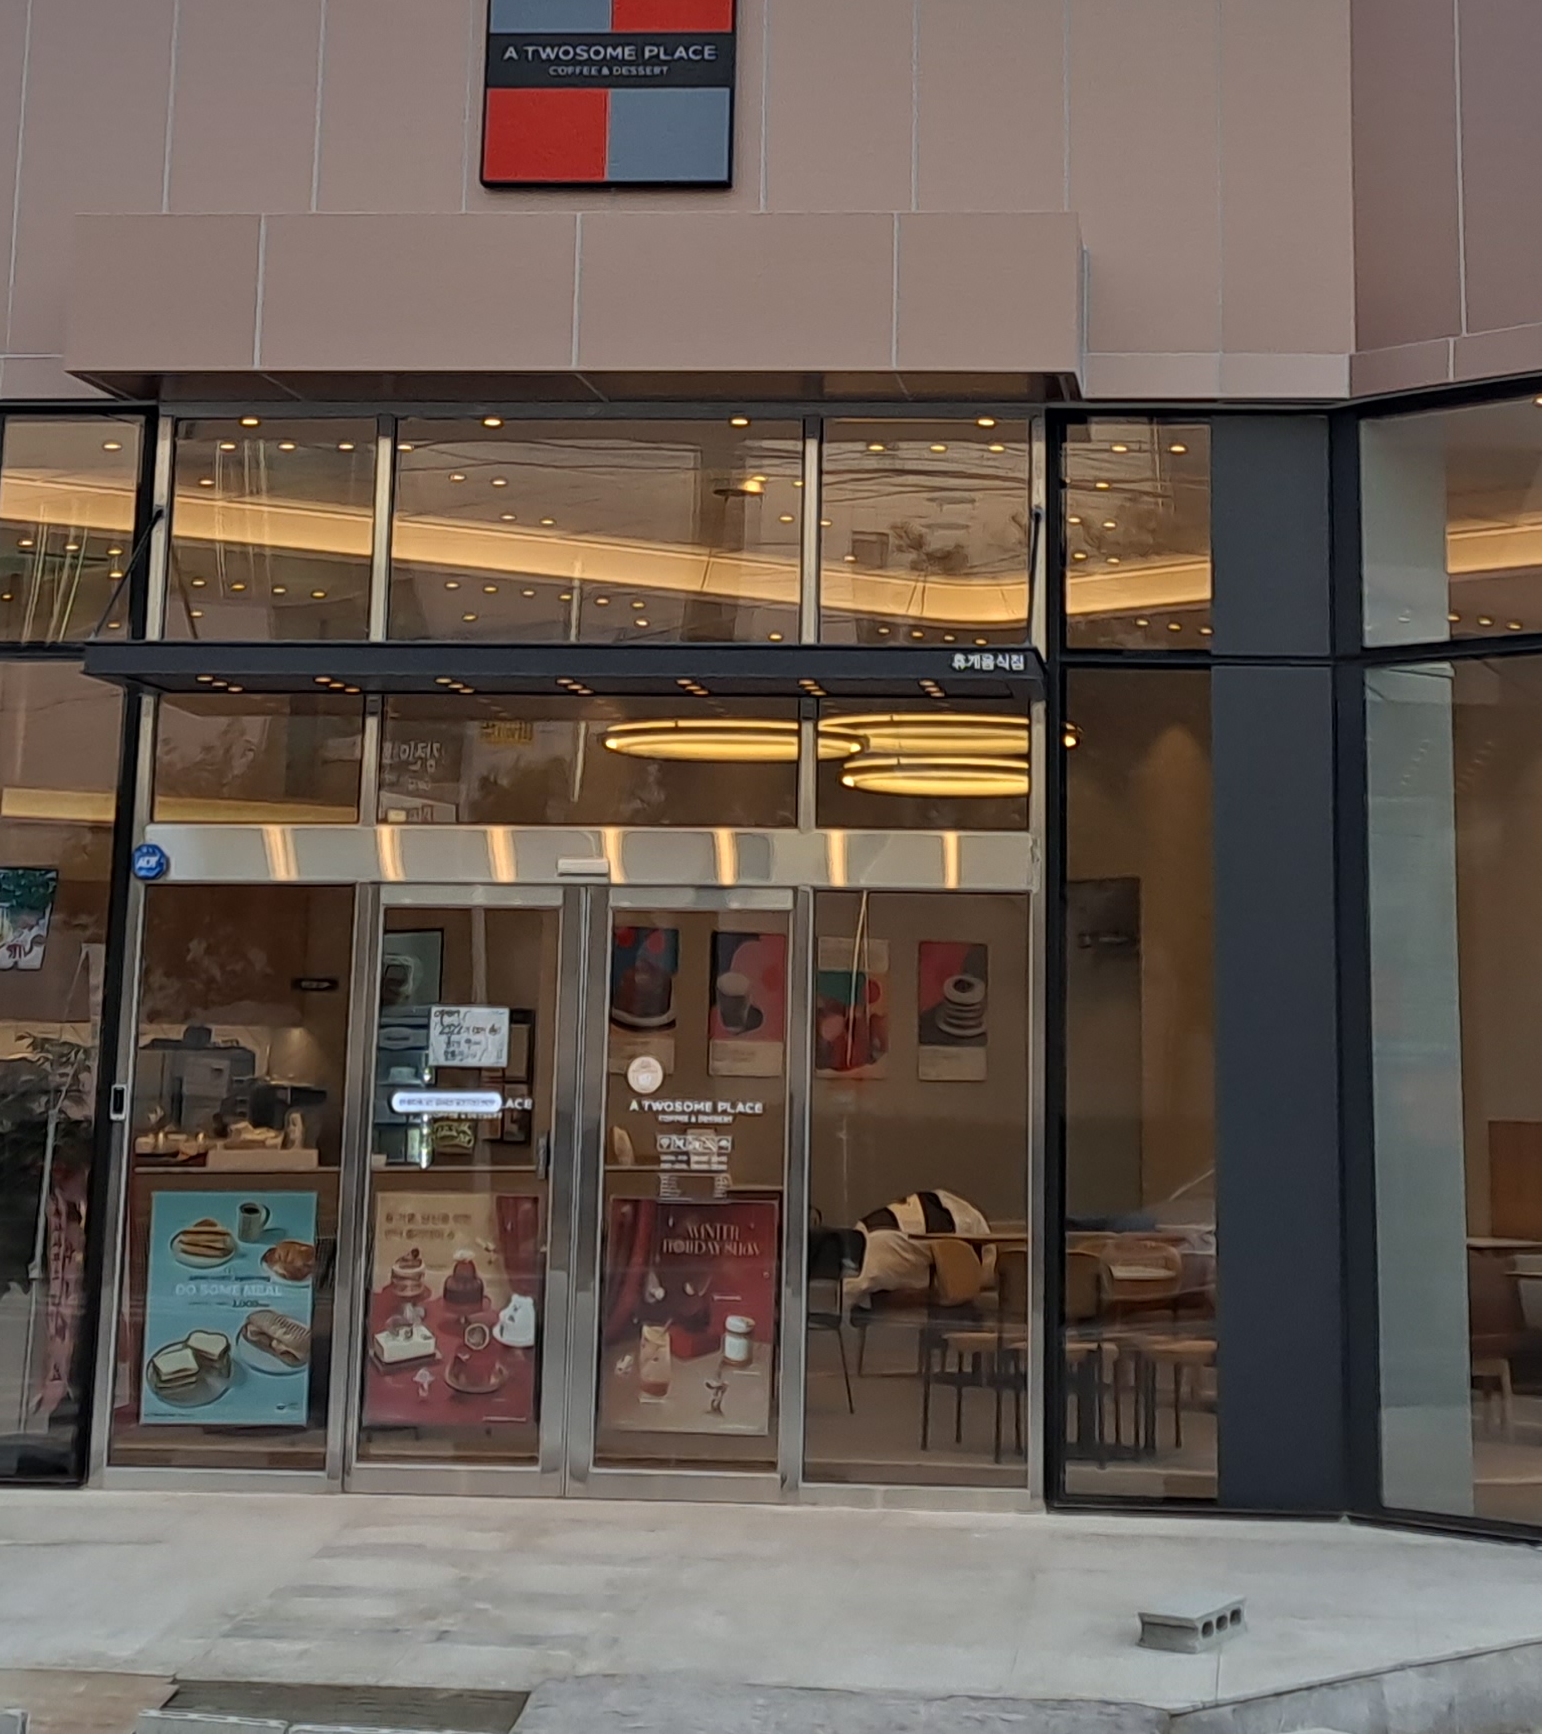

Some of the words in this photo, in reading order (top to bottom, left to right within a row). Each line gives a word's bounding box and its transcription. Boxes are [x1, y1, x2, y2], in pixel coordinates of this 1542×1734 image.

[503, 46, 518, 61] A
[523, 45, 637, 61] TWOSOME
[644, 45, 718, 61] PLACE
[549, 66, 598, 76] COFFEE
[613, 66, 669, 76] DESSERT
[952, 652, 1025, 671] 휴게음식점
[629, 1099, 639, 1111] A
[641, 1100, 713, 1113] TWOSOME
[717, 1102, 763, 1114] PLACE
